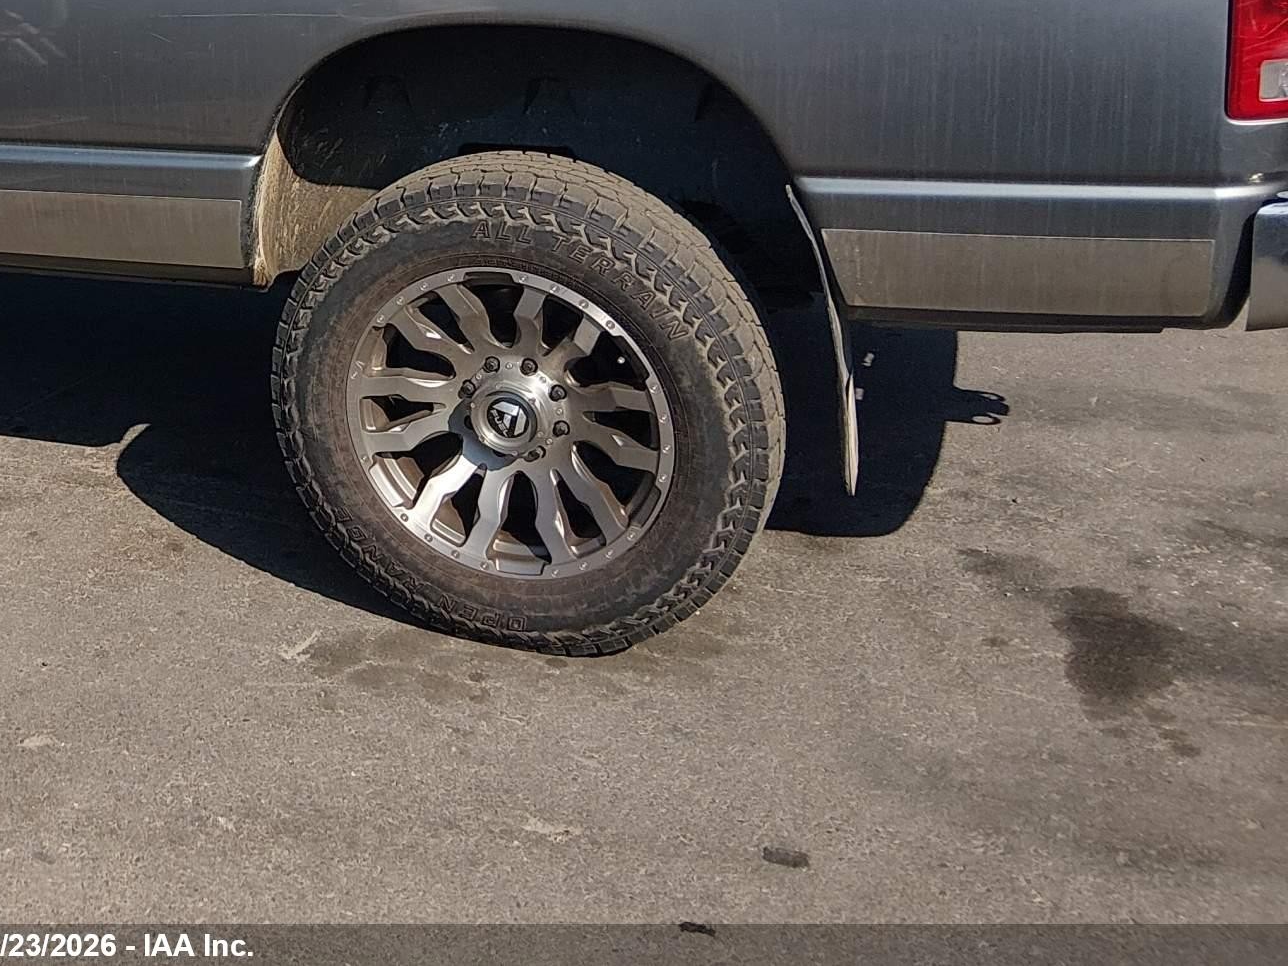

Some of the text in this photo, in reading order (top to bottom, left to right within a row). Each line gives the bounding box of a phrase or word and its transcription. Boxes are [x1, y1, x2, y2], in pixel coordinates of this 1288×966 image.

[471, 220, 689, 340] ALL TERRAIN
[333, 506, 527, 632] OPEN RANGE
